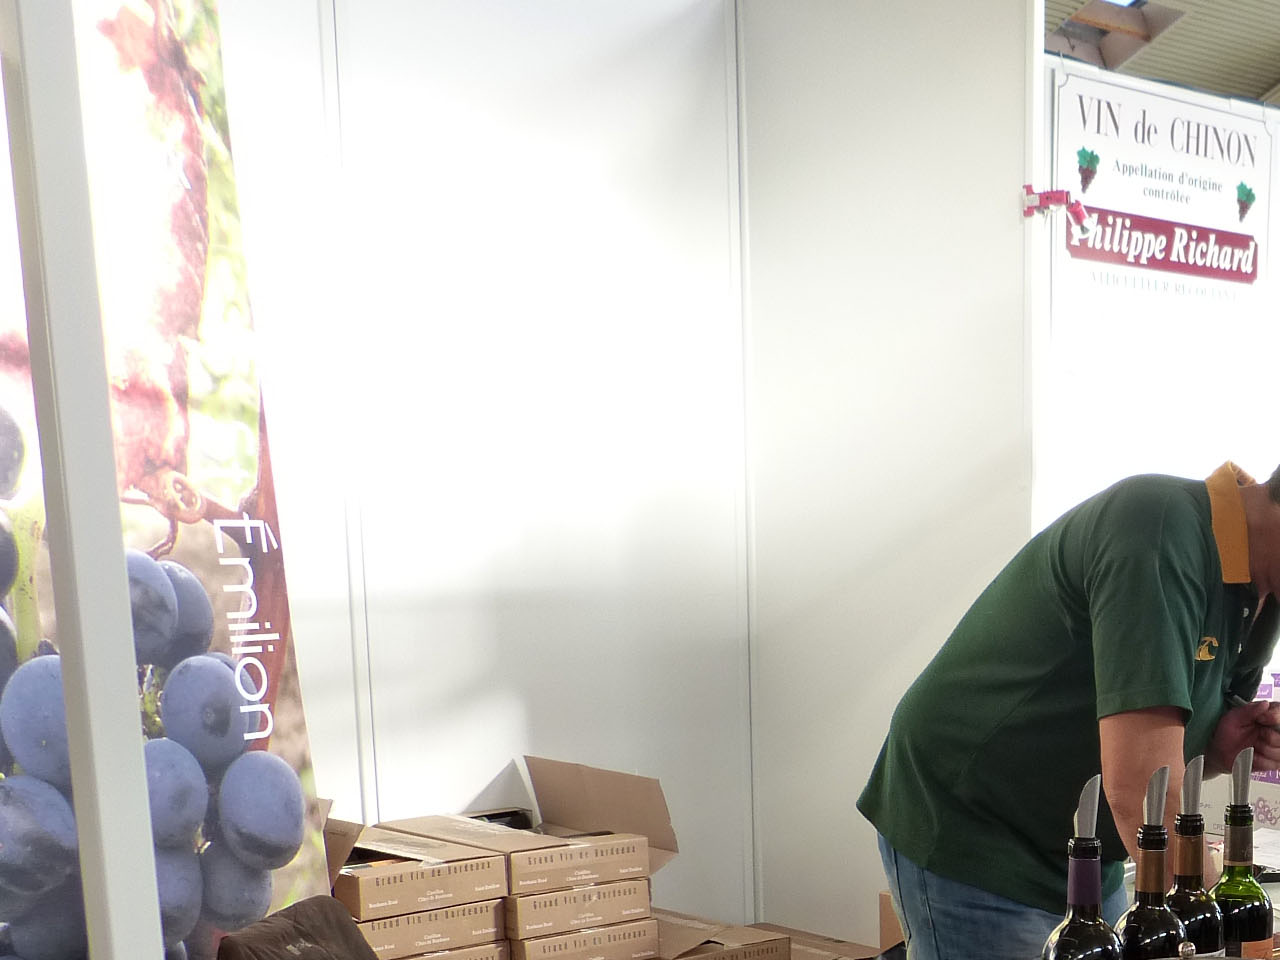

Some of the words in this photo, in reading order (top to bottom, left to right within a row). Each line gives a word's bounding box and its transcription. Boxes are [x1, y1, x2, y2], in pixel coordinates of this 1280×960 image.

[1077, 94, 1122, 138] VIN
[1134, 109, 1158, 146] de
[1170, 117, 1257, 168] CHINON
[1112, 159, 1175, 184] Appellation
[1178, 171, 1223, 193] d'origine
[1143, 186, 1191, 205] contrôlée
[1170, 227, 1256, 275] Richard
[213, 511, 279, 741] Émilion
